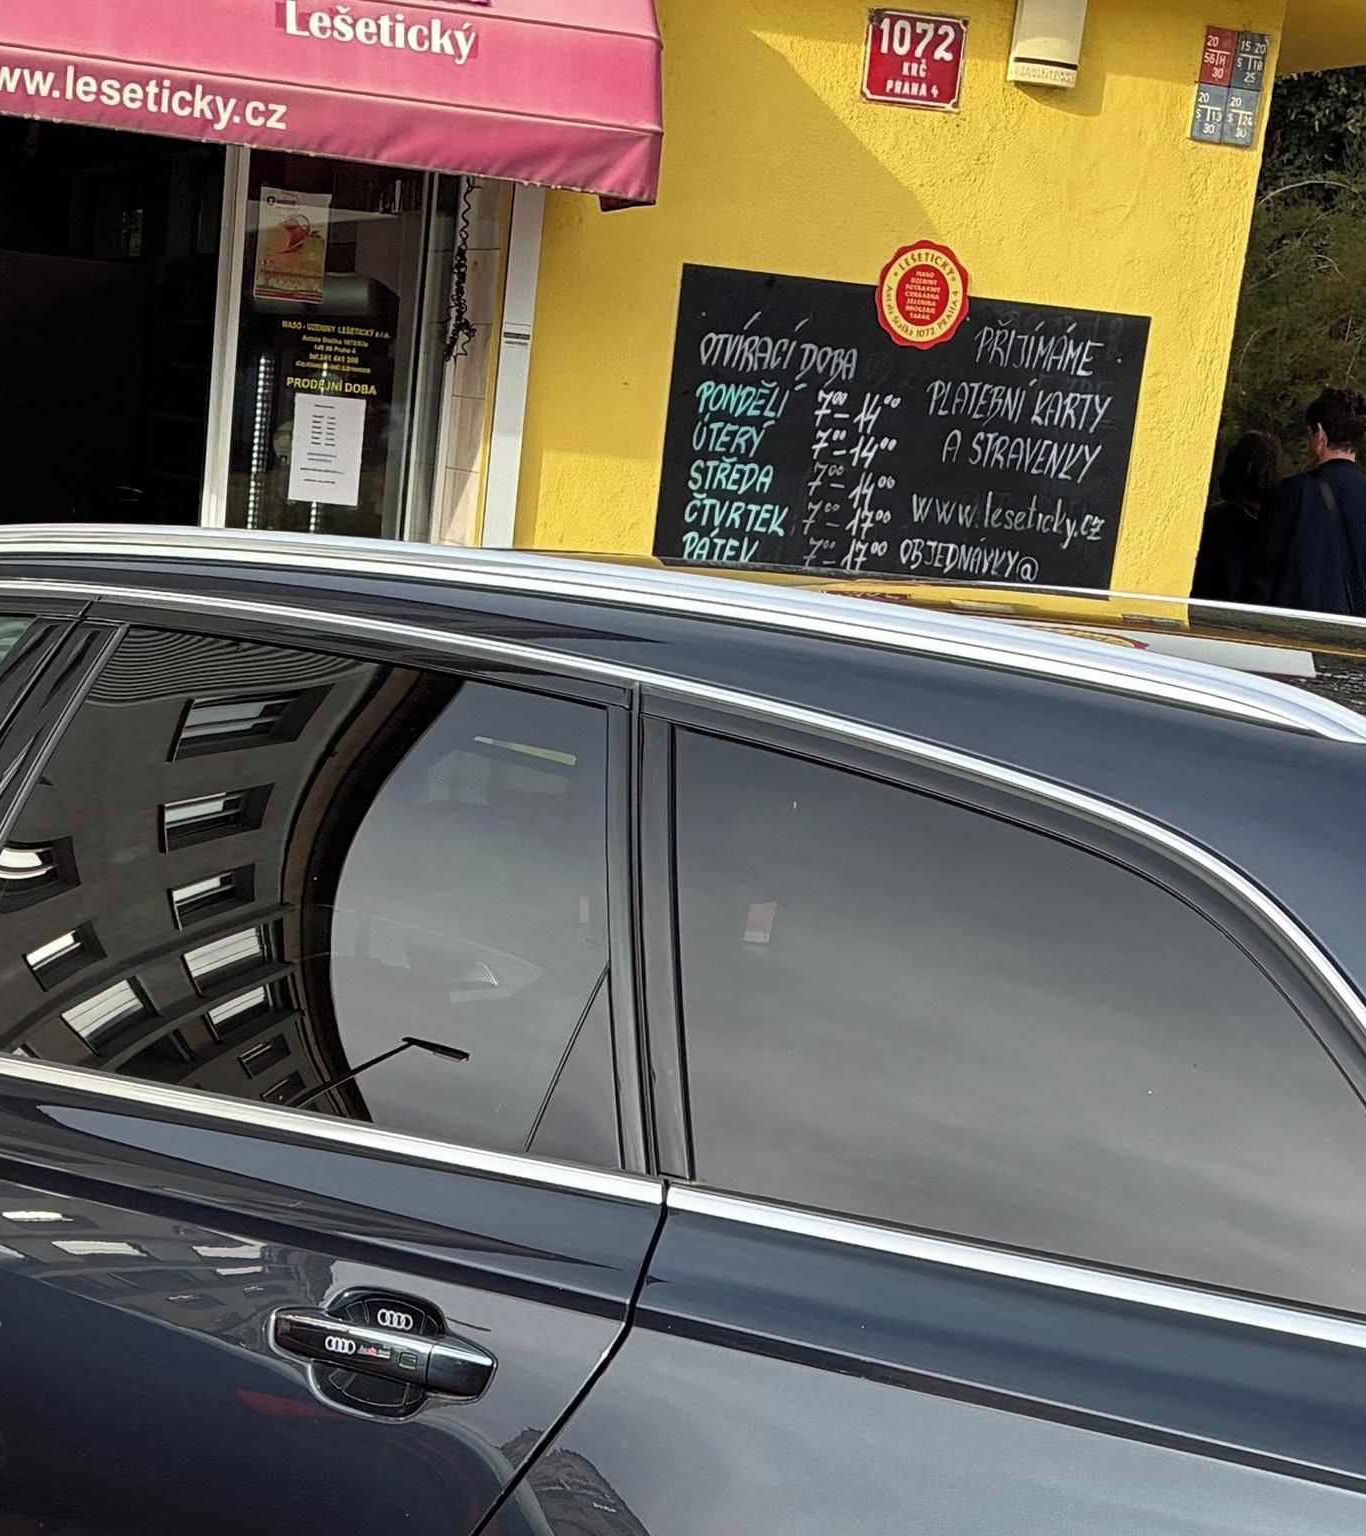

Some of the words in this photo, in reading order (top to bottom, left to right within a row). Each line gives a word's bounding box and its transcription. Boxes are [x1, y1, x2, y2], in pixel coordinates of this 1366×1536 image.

[285, 0, 477, 65] Lešetický
[880, 18, 955, 61] 1072
[1207, 35, 1219, 47] 20
[1241, 40, 1251, 51] 15
[1255, 43, 1266, 54] 20
[902, 59, 927, 78] KRČ
[1237, 58, 1243, 68] S
[1212, 68, 1224, 79] 30
[1244, 72, 1255, 83] 25
[886, 80, 927, 97] PRAHA
[931, 85, 939, 98] 4
[1198, 92, 1209, 103] 20
[1230, 96, 1242, 107] 20
[1195, 108, 1201, 119] S
[1212, 111, 1222, 122] 13
[1203, 123, 1215, 134] 30
[975, 319, 1104, 376] PŘIJÍMÁME
[795, 343, 858, 388] DOBA
[286, 376, 343, 392] PRODEJNÍ
[345, 383, 377, 395] DOBA
[696, 380, 807, 418] PONDĚLÍ
[927, 378, 1037, 426] PLATEBNÍ
[1031, 390, 1112, 433] KARTY
[692, 412, 775, 457] ÚTERÝ
[942, 430, 962, 462] A
[969, 432, 1102, 483] STRAVENKY
[688, 456, 774, 495] STŘEDA
[685, 492, 789, 537] ČTVRTEK
[912, 491, 1105, 549] www.leseticky.cz
